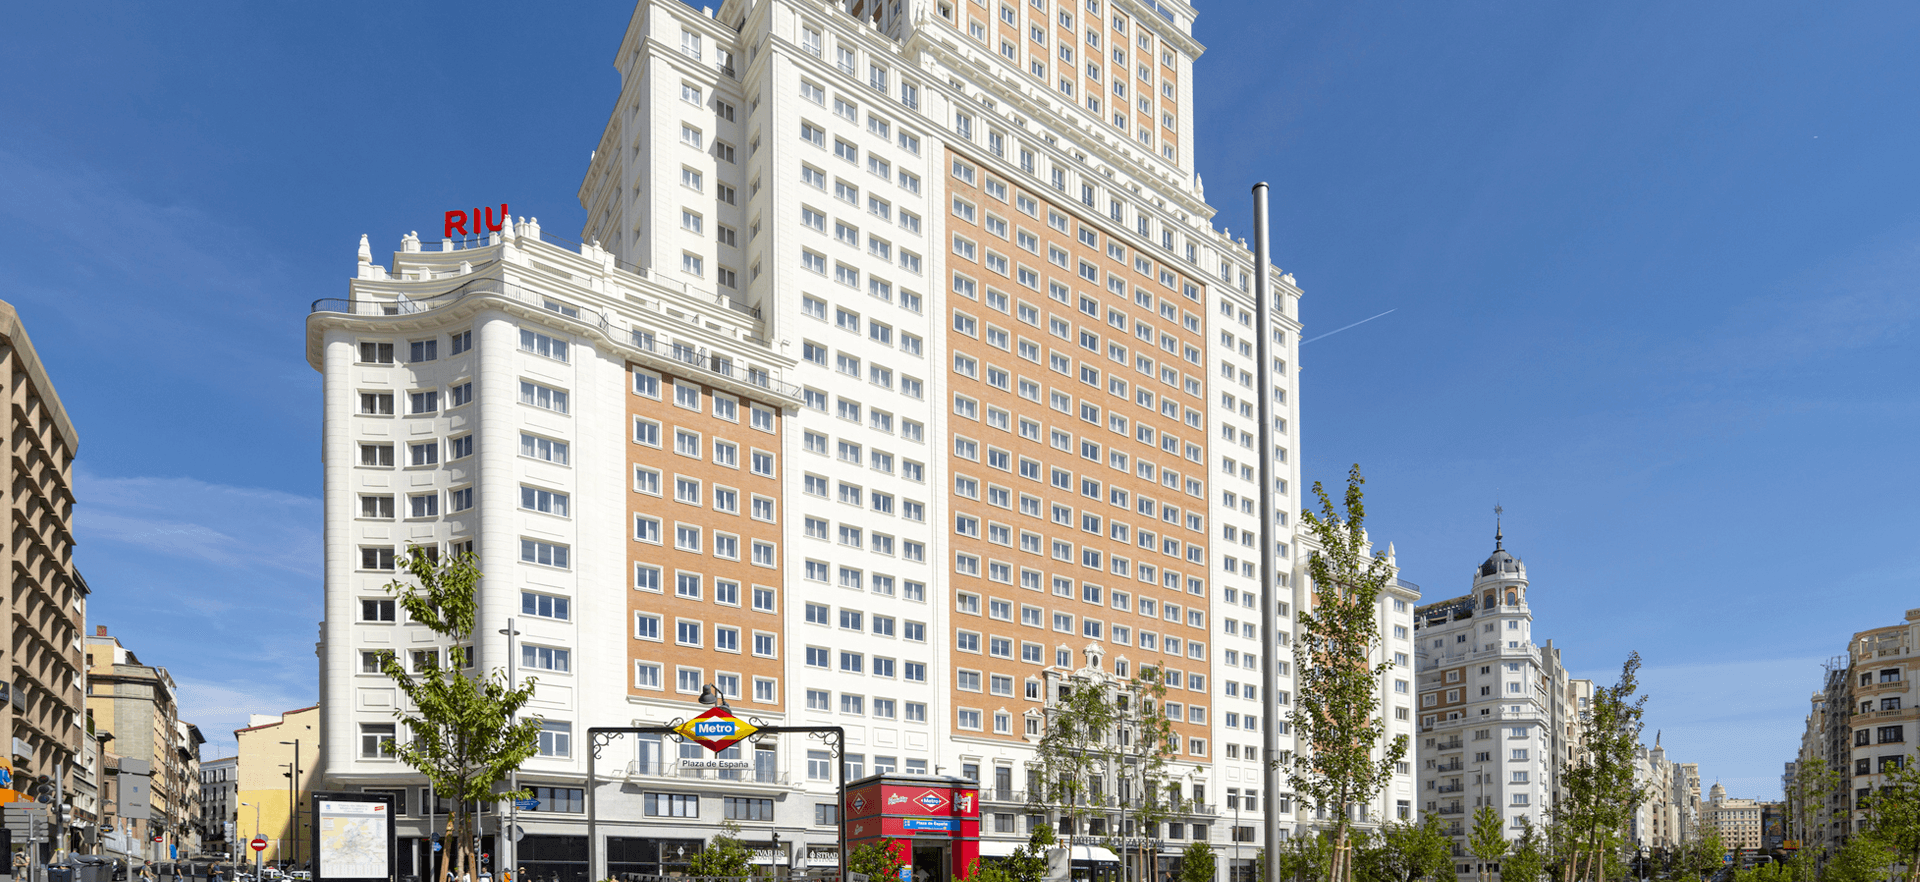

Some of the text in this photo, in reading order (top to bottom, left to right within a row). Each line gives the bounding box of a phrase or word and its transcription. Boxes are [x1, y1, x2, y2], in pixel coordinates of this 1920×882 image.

[444, 203, 508, 238] RIU
[698, 724, 733, 733] Metro
[706, 760, 717, 768] de
[718, 761, 749, 769] España
